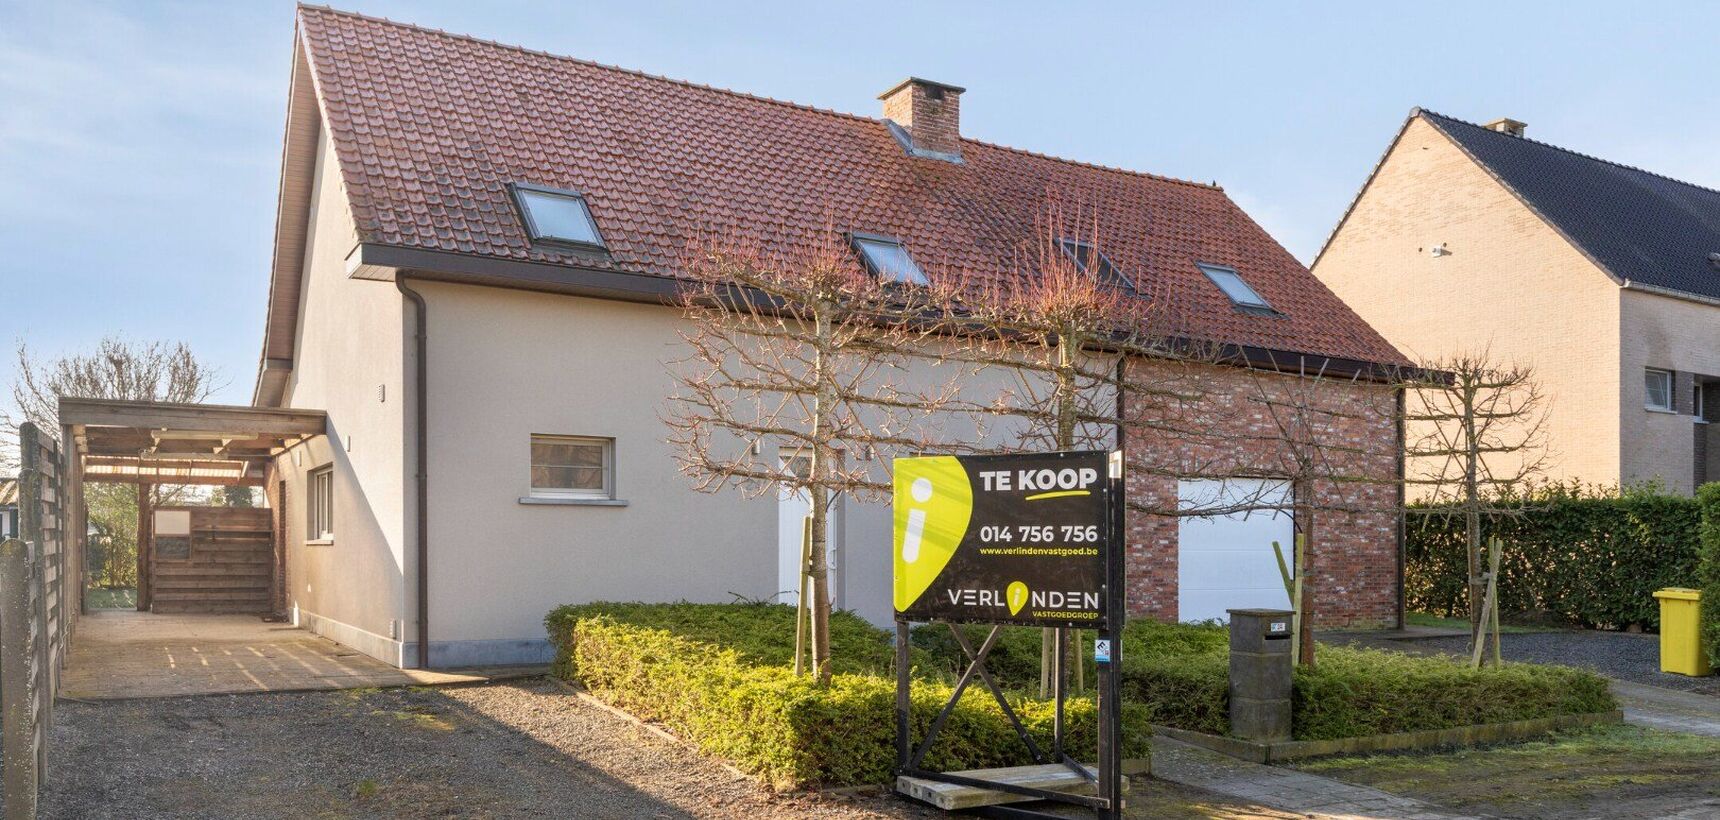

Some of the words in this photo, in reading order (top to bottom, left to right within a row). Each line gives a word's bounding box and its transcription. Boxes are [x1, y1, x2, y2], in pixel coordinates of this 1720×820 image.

[980, 471, 1011, 491] TE
[1019, 468, 1098, 490] KOOP
[980, 526, 1012, 542] 014
[1019, 526, 1054, 542] 756
[1061, 526, 1098, 542] 756
[980, 546, 1098, 556] www.verlindenvastgoed.be
[1032, 611, 1099, 619] VASTGOEDGROEP
